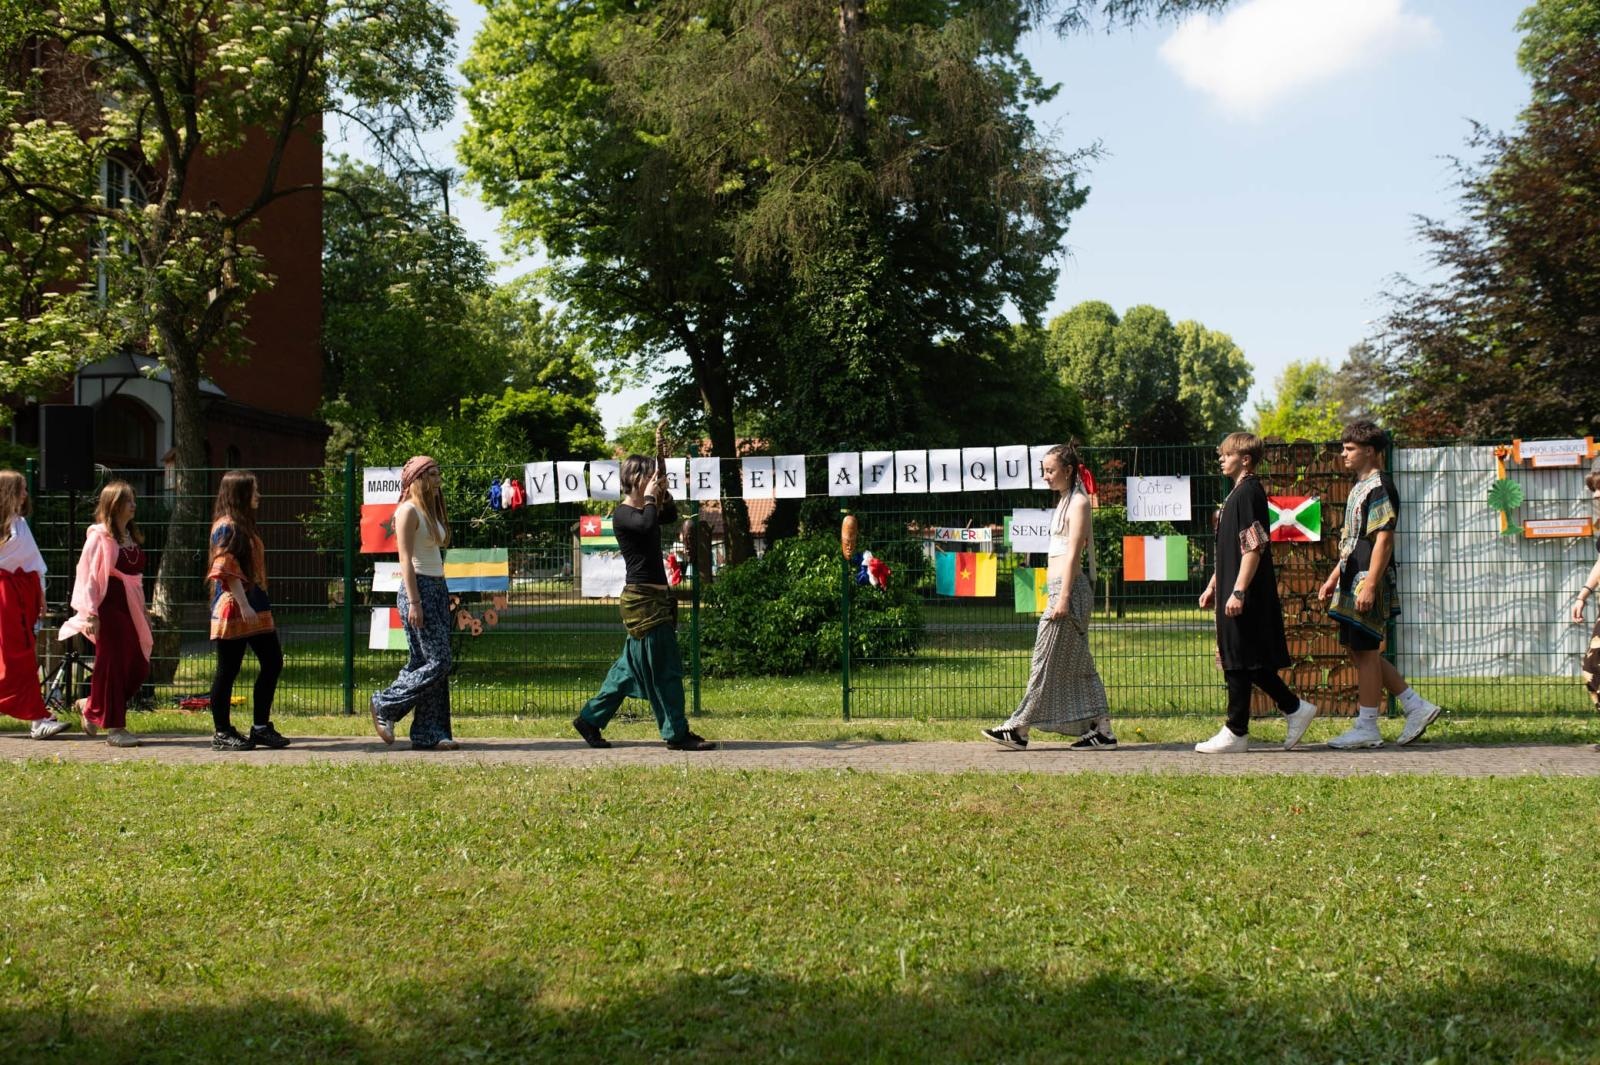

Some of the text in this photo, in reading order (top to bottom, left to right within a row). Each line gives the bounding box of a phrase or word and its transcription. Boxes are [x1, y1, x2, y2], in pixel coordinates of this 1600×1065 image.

[532, 459, 1044, 494] VOYGE EN AFRIQU
[368, 480, 401, 492] MAROK
[1137, 479, 1173, 495] Côte
[935, 528, 991, 540] KAMERUN
[1012, 525, 1052, 537] SENE
